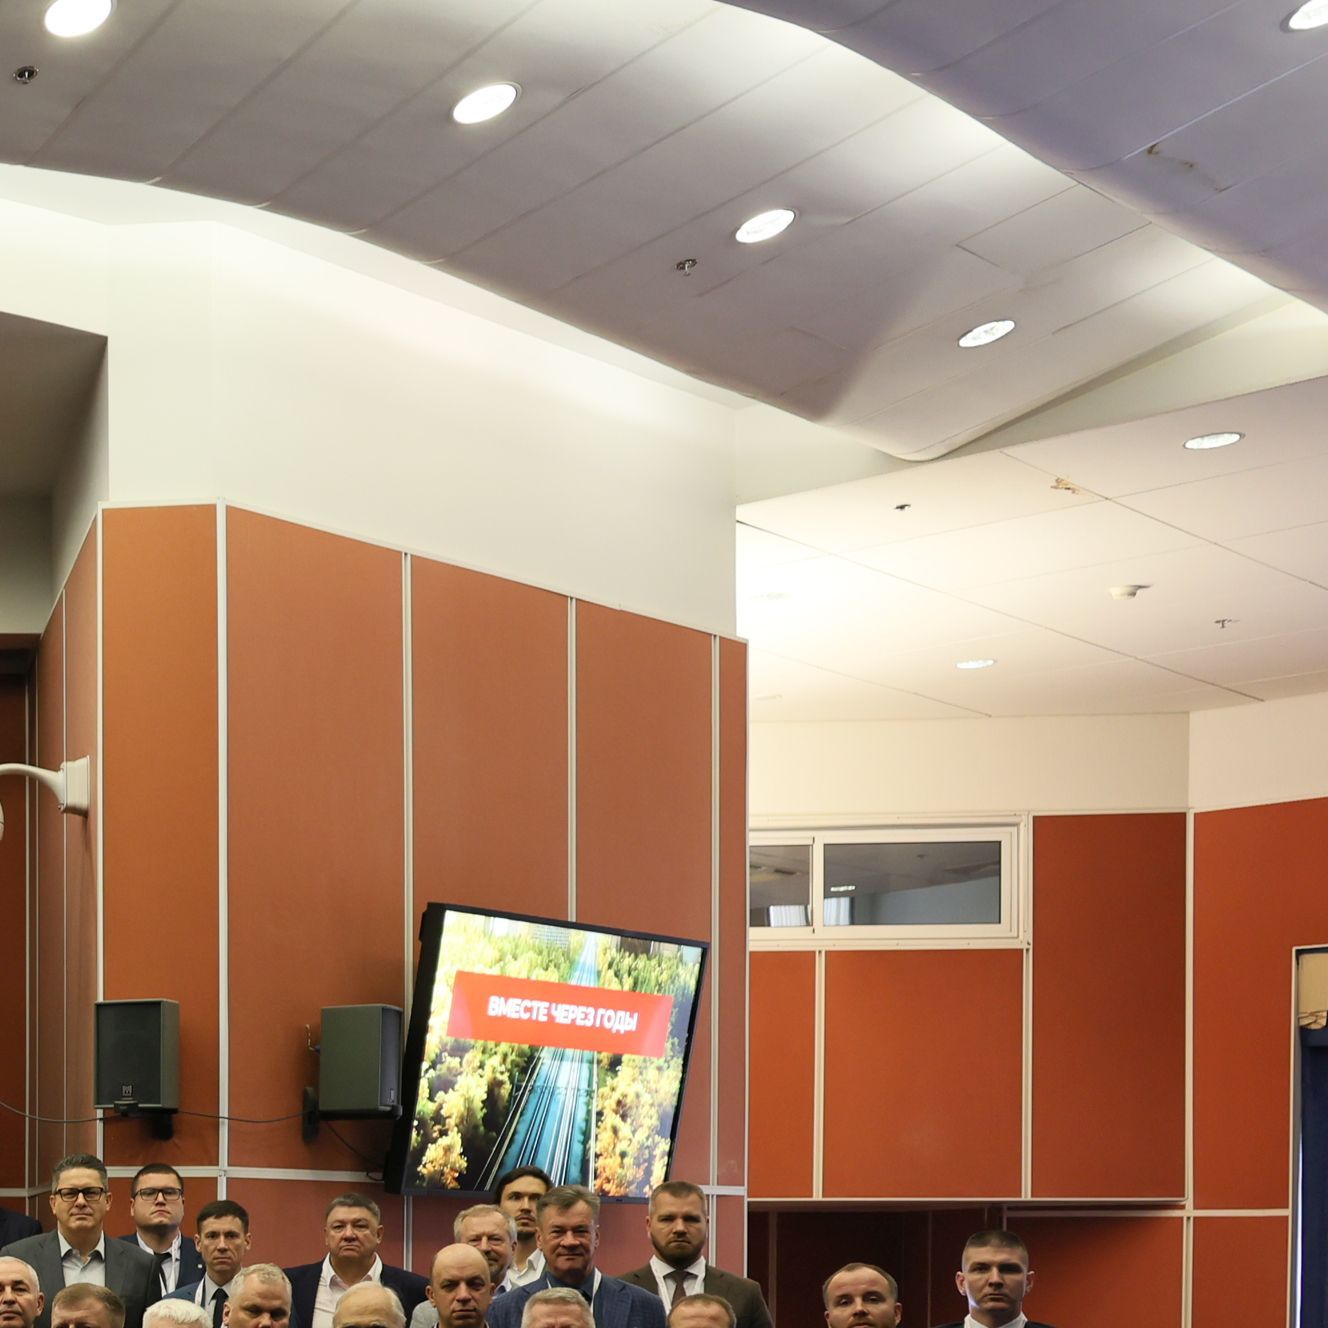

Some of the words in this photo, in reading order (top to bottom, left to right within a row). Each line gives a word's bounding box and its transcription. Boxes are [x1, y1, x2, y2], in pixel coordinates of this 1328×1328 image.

[487, 995, 550, 1022] ВМЕСТЕ
[551, 1002, 595, 1027] ЧЕРЕЗ
[595, 1007, 638, 1034] ГОДЫ
